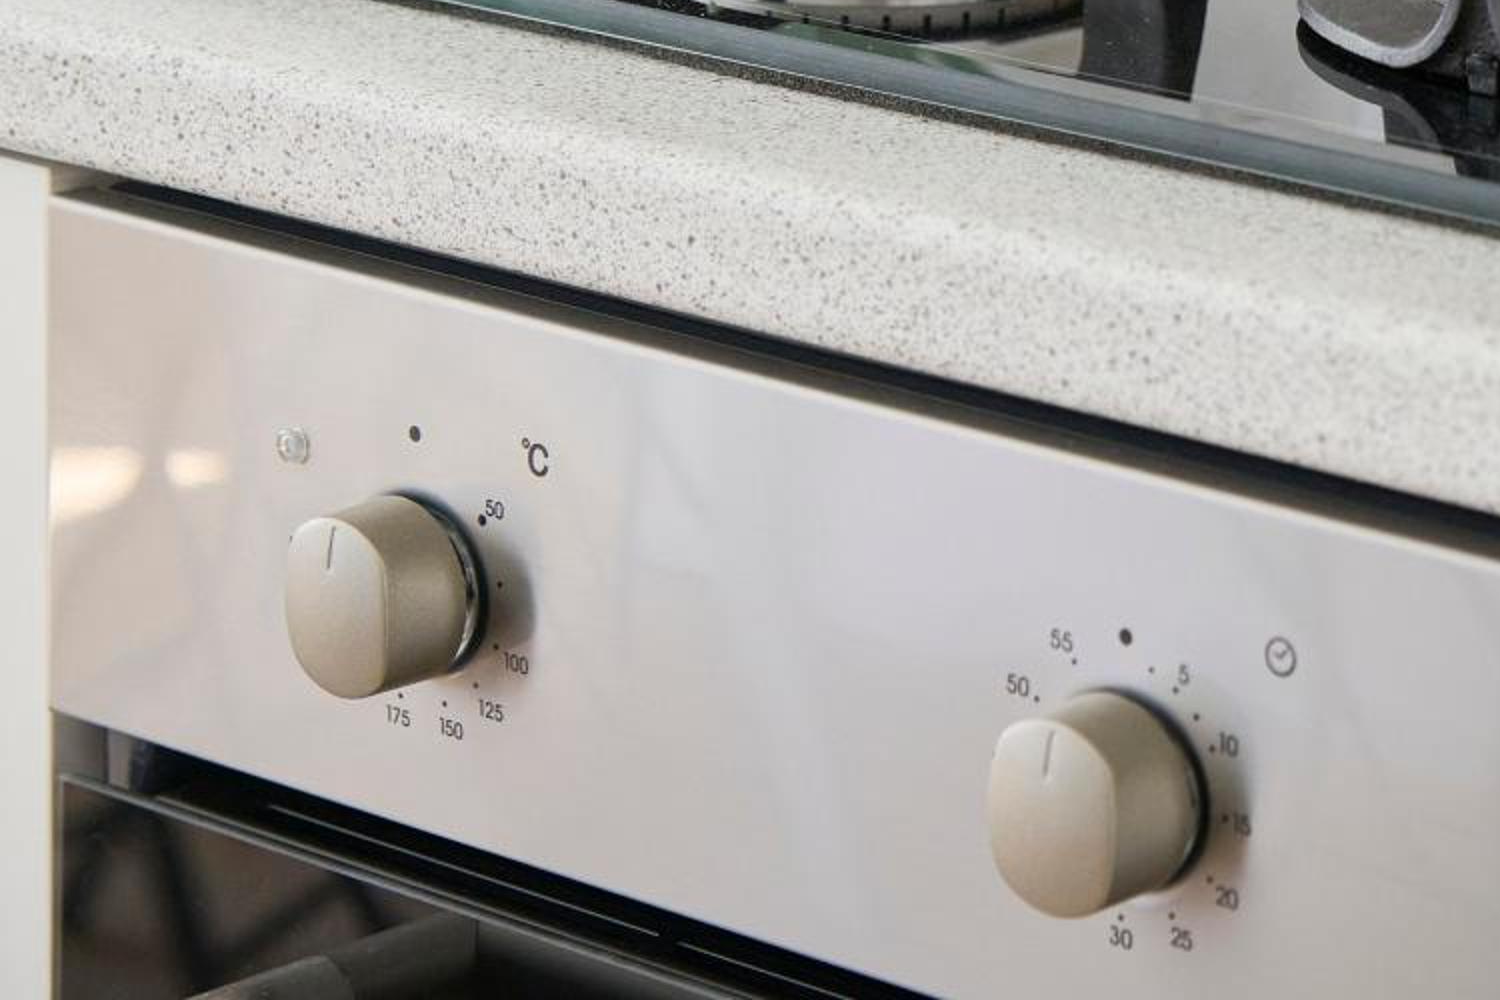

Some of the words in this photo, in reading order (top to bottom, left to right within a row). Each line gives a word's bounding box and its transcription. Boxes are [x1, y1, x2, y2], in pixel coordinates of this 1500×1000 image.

[485, 499, 505, 520] 50
[1050, 628, 1073, 652] 55
[503, 652, 529, 675] 100
[1178, 664, 1191, 686] 5
[1006, 673, 1030, 697] 50
[386, 704, 411, 727] 175
[479, 700, 504, 723] 125
[440, 717, 464, 740] 150
[1219, 732, 1239, 757] 10
[1233, 813, 1252, 837] 15
[1215, 887, 1239, 911] 20
[1109, 925, 1133, 950] 30
[1170, 927, 1193, 951] 25
